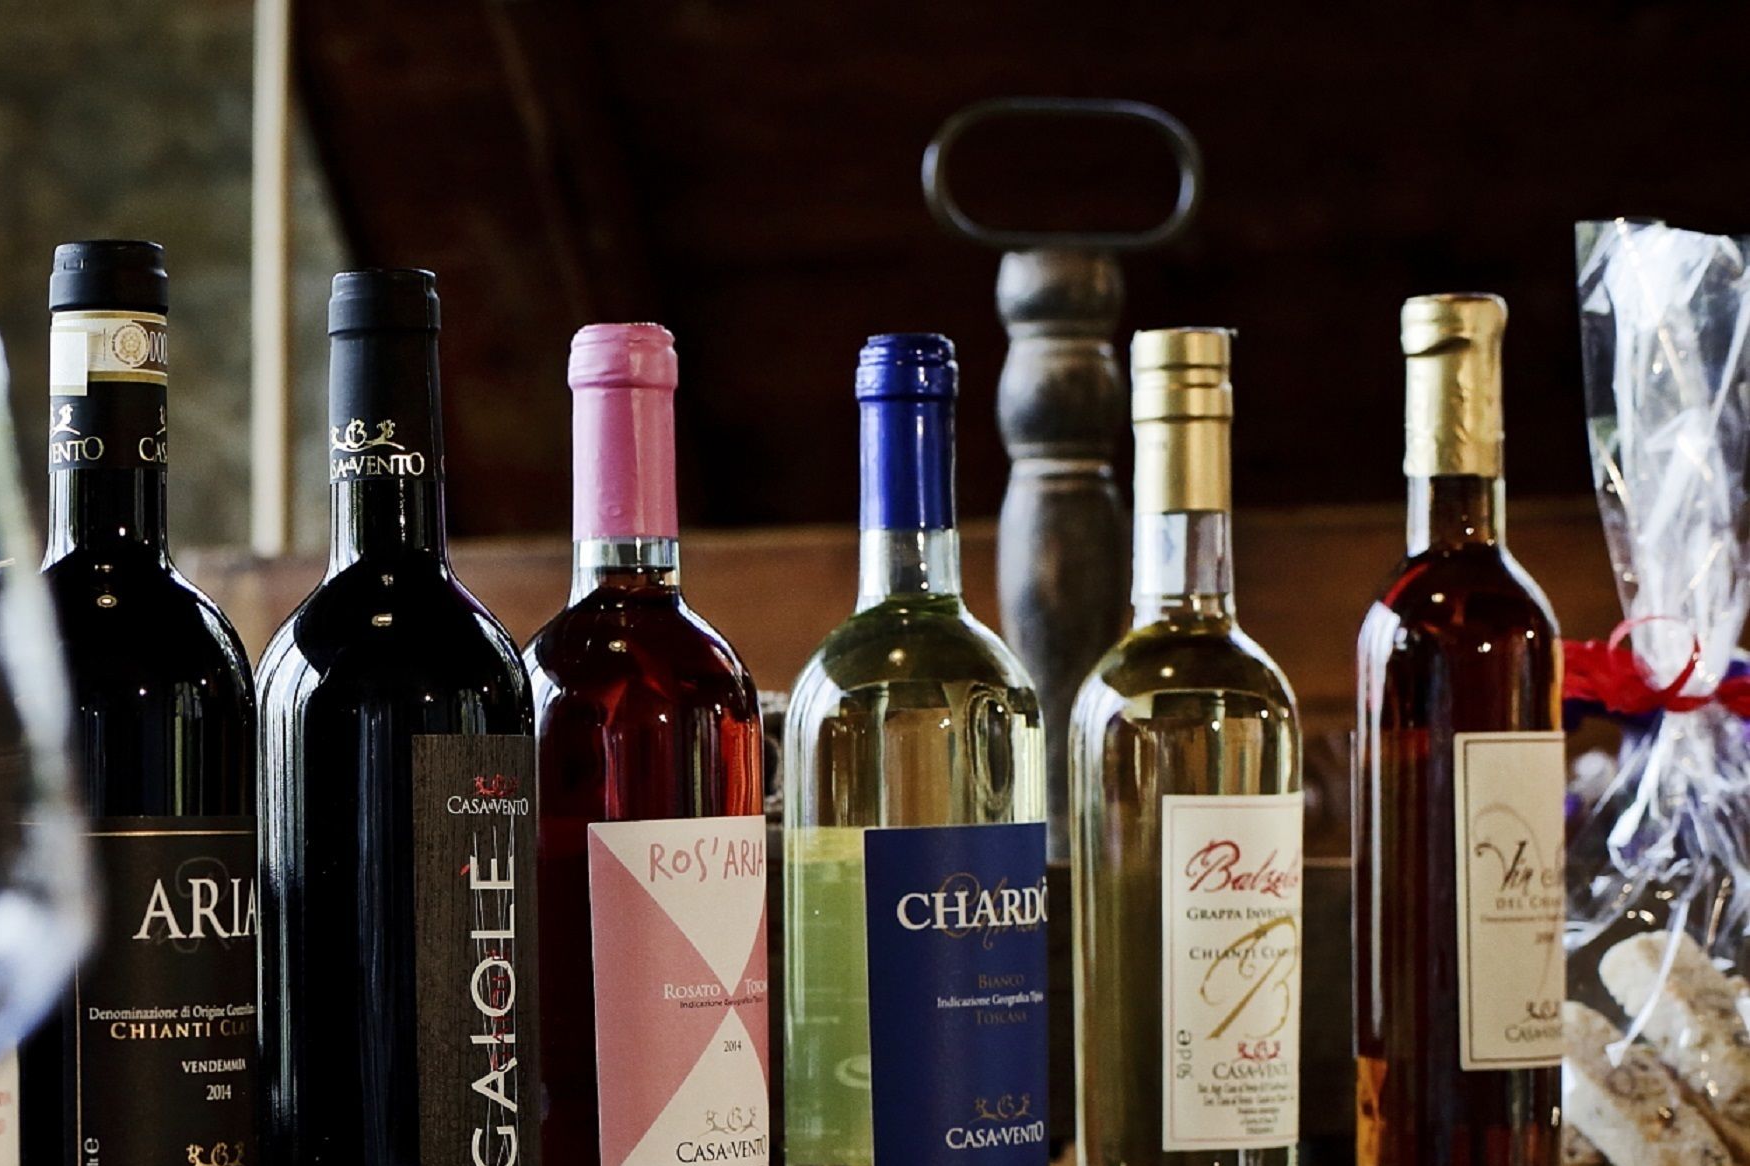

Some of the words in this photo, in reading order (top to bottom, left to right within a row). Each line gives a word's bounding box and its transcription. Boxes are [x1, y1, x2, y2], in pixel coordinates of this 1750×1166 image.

[50, 436, 104, 463] ENTO
[132, 878, 258, 940] ARIA
[1186, 907, 1243, 920] GRAPPA
[663, 983, 721, 999] ROSATO
[89, 1006, 178, 1021] Denominazione
[180, 1005, 191, 1018] di
[110, 1021, 211, 1040] CHIANTI
[723, 1040, 742, 1053] 2014
[206, 1084, 232, 1101] 2014
